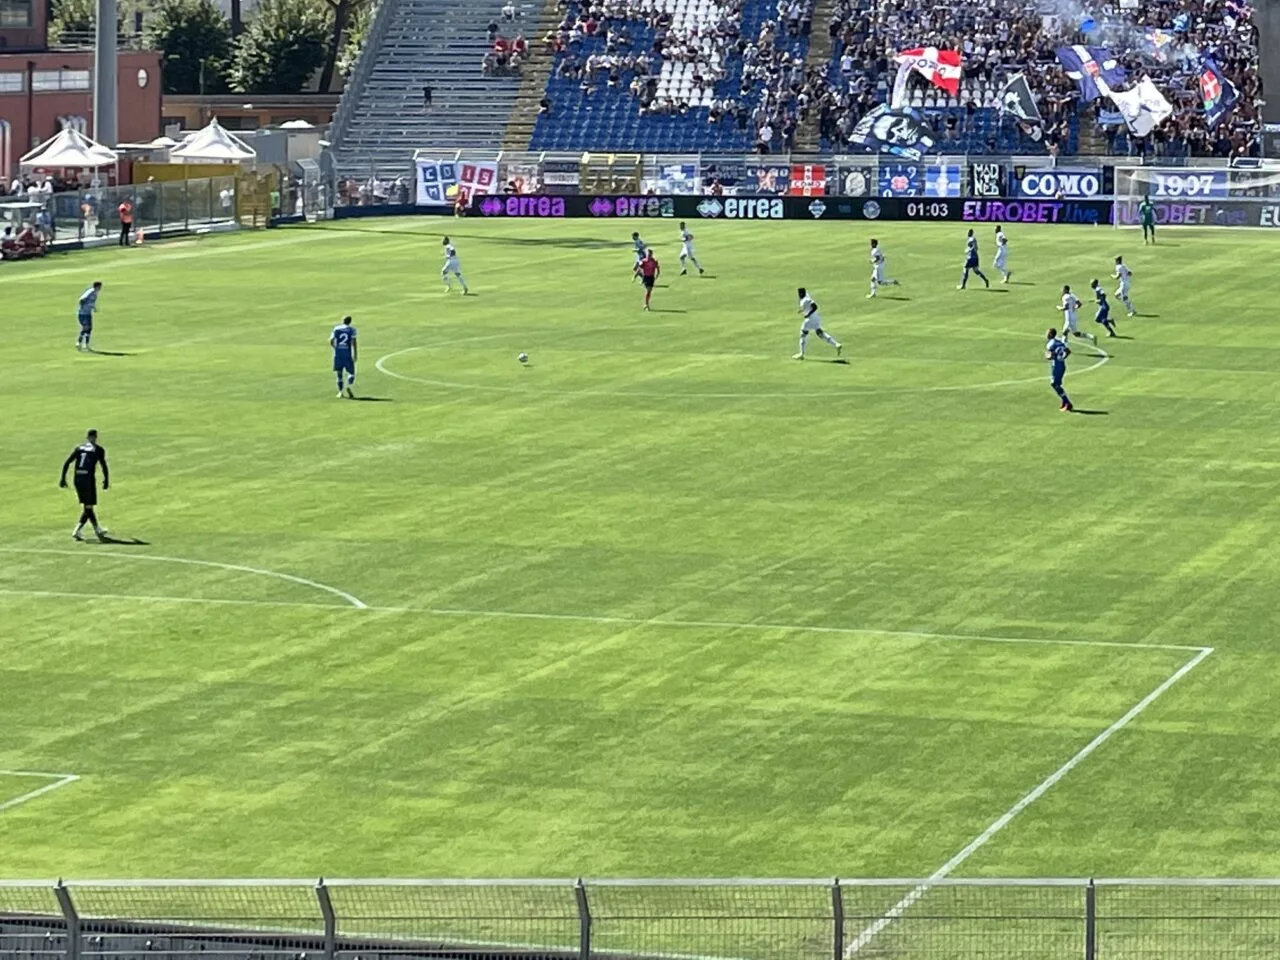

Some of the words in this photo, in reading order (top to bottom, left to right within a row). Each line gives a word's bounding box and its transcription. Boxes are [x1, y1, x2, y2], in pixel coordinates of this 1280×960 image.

[1021, 174, 1099, 195] COMO
[1155, 175, 1214, 196] 1907
[907, 203, 948, 217] 01:03
[339, 333, 349, 345] 2
[79, 452, 87, 468] 1
